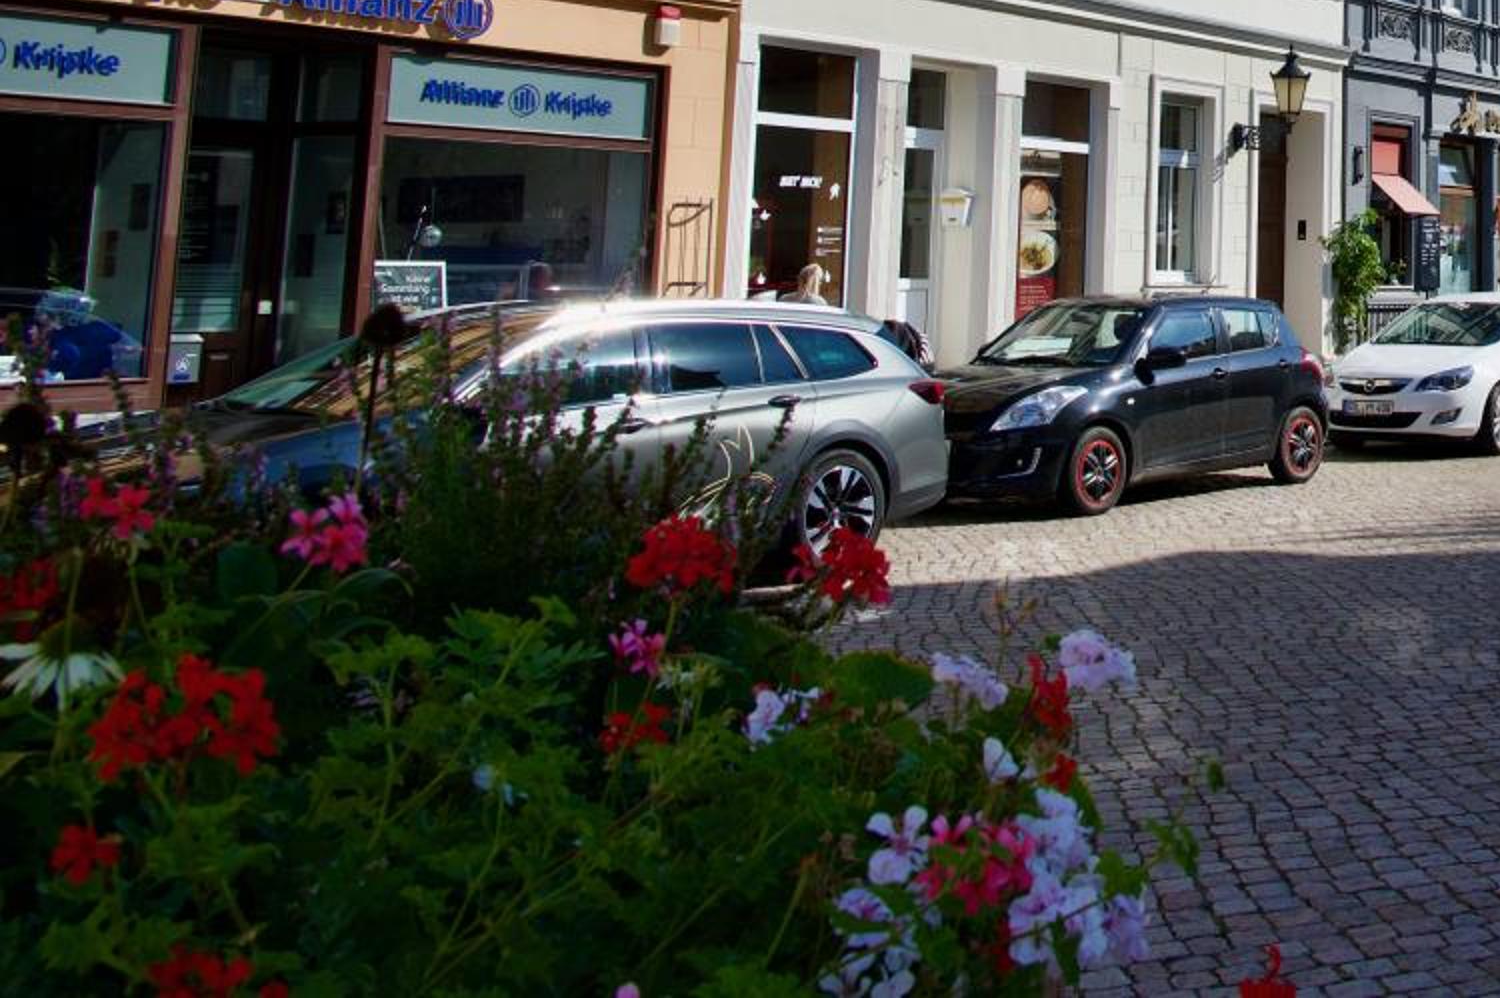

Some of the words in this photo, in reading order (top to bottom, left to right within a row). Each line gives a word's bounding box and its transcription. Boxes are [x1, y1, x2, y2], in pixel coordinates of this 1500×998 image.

[12, 41, 120, 79] Kripke
[420, 79, 505, 109] Allianz
[545, 91, 613, 120] Kripke
